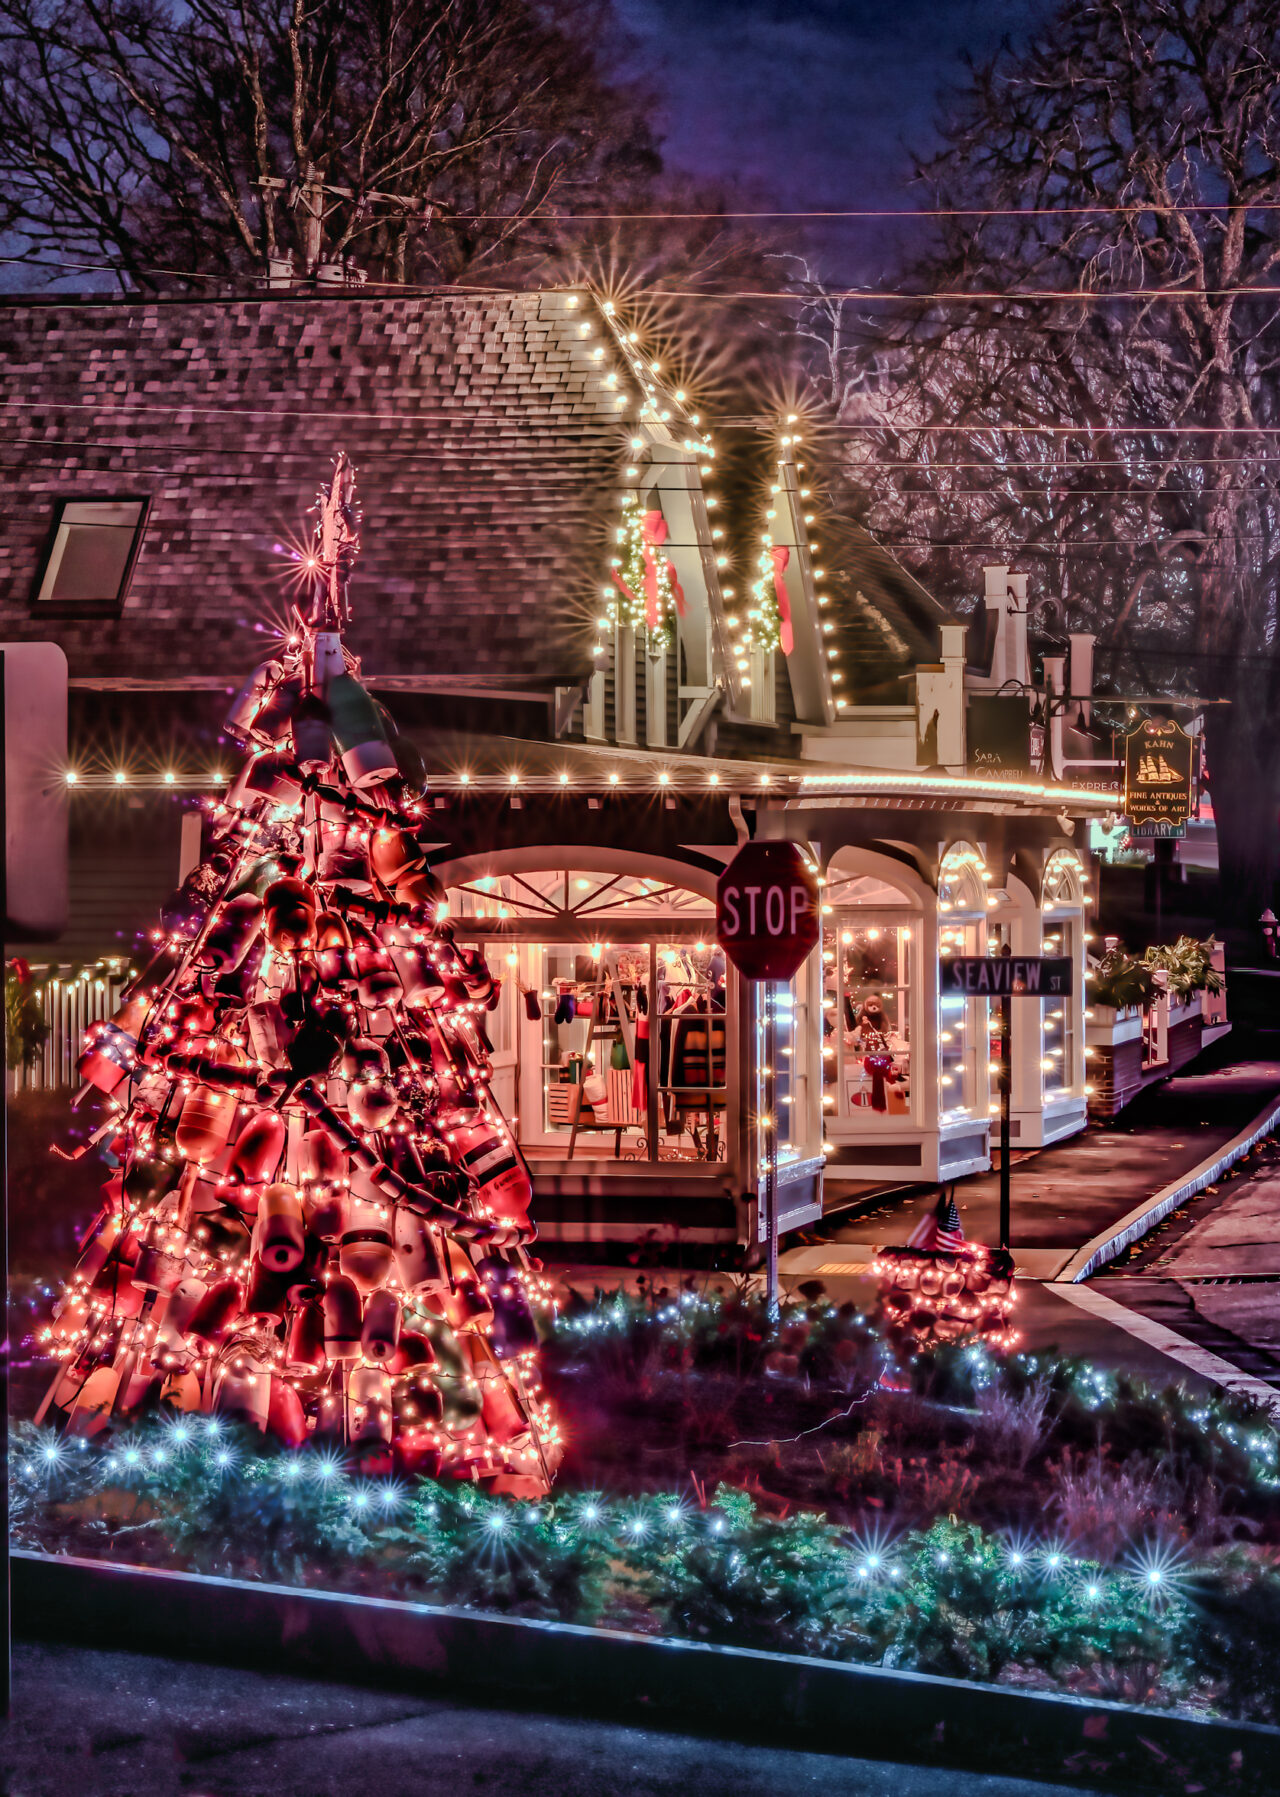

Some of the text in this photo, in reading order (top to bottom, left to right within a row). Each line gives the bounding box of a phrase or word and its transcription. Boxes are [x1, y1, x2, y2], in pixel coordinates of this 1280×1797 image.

[1144, 740, 1174, 750] KAHN
[974, 748, 1002, 763] SARA
[1129, 791, 1188, 801] FINE ANTIQUES
[1129, 804, 1187, 813] WORKS OF ART
[1132, 823, 1173, 836] LIBRARY
[721, 885, 809, 936] STOP
[952, 961, 1062, 991] SEAVIEW ST
